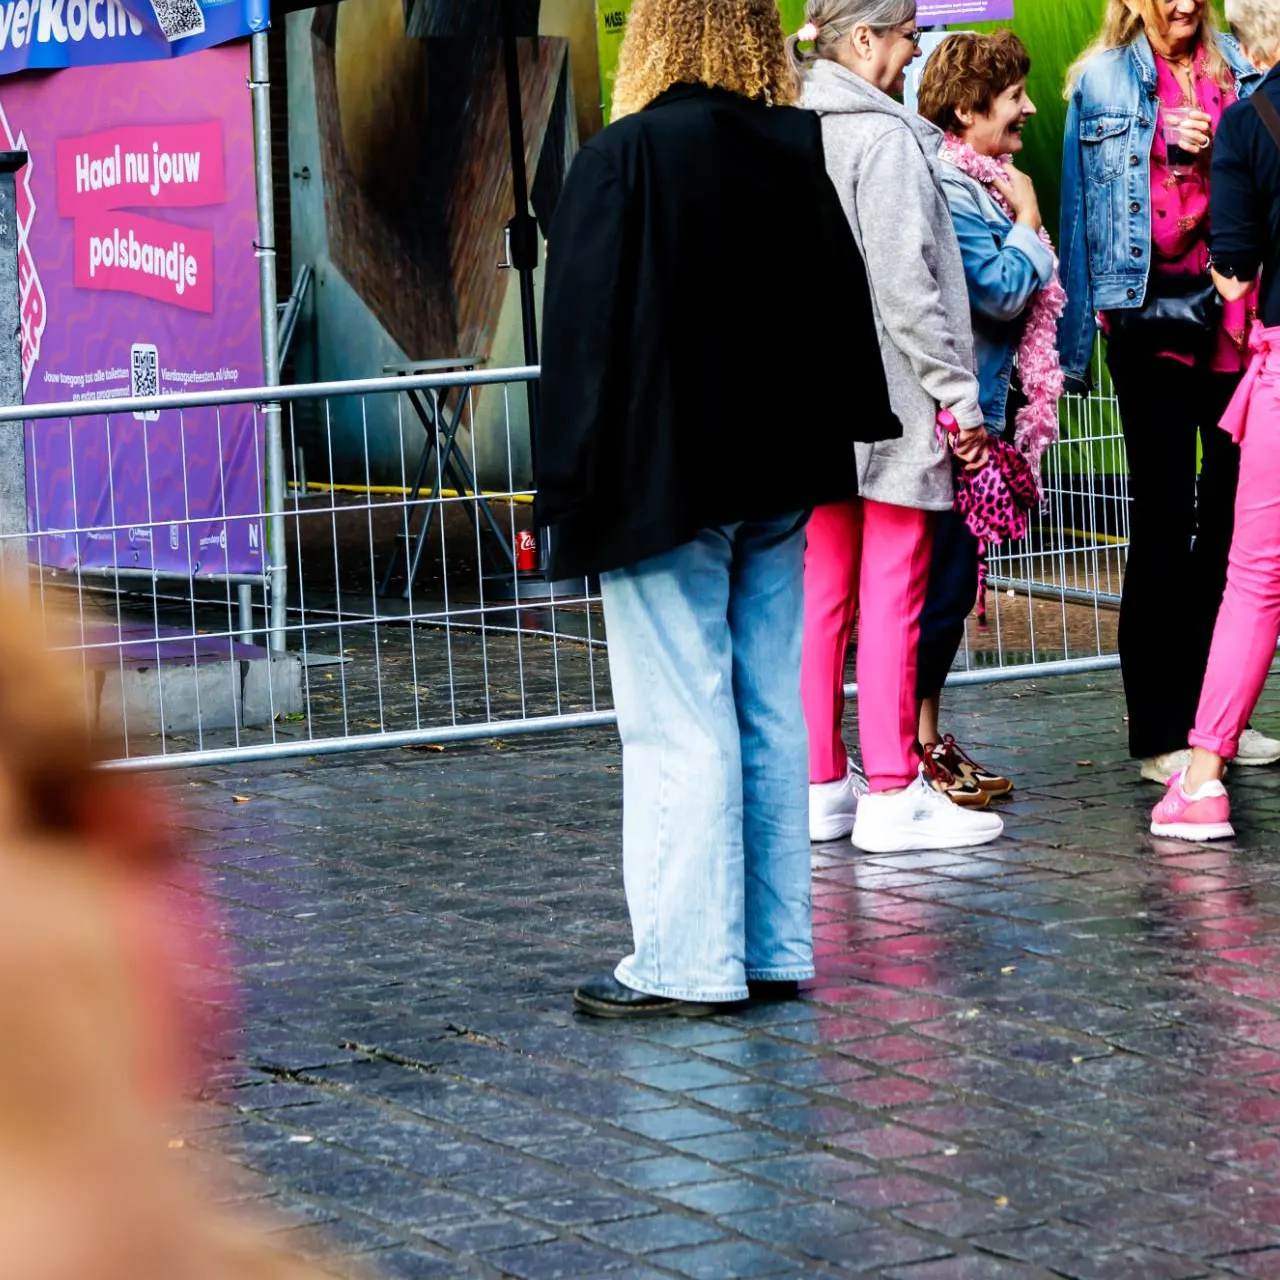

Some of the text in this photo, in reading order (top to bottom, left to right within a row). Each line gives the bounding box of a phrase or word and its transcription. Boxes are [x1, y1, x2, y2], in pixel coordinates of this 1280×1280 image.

[75, 141, 201, 196] Haal nu jouw
[90, 228, 198, 295] polsbandje
